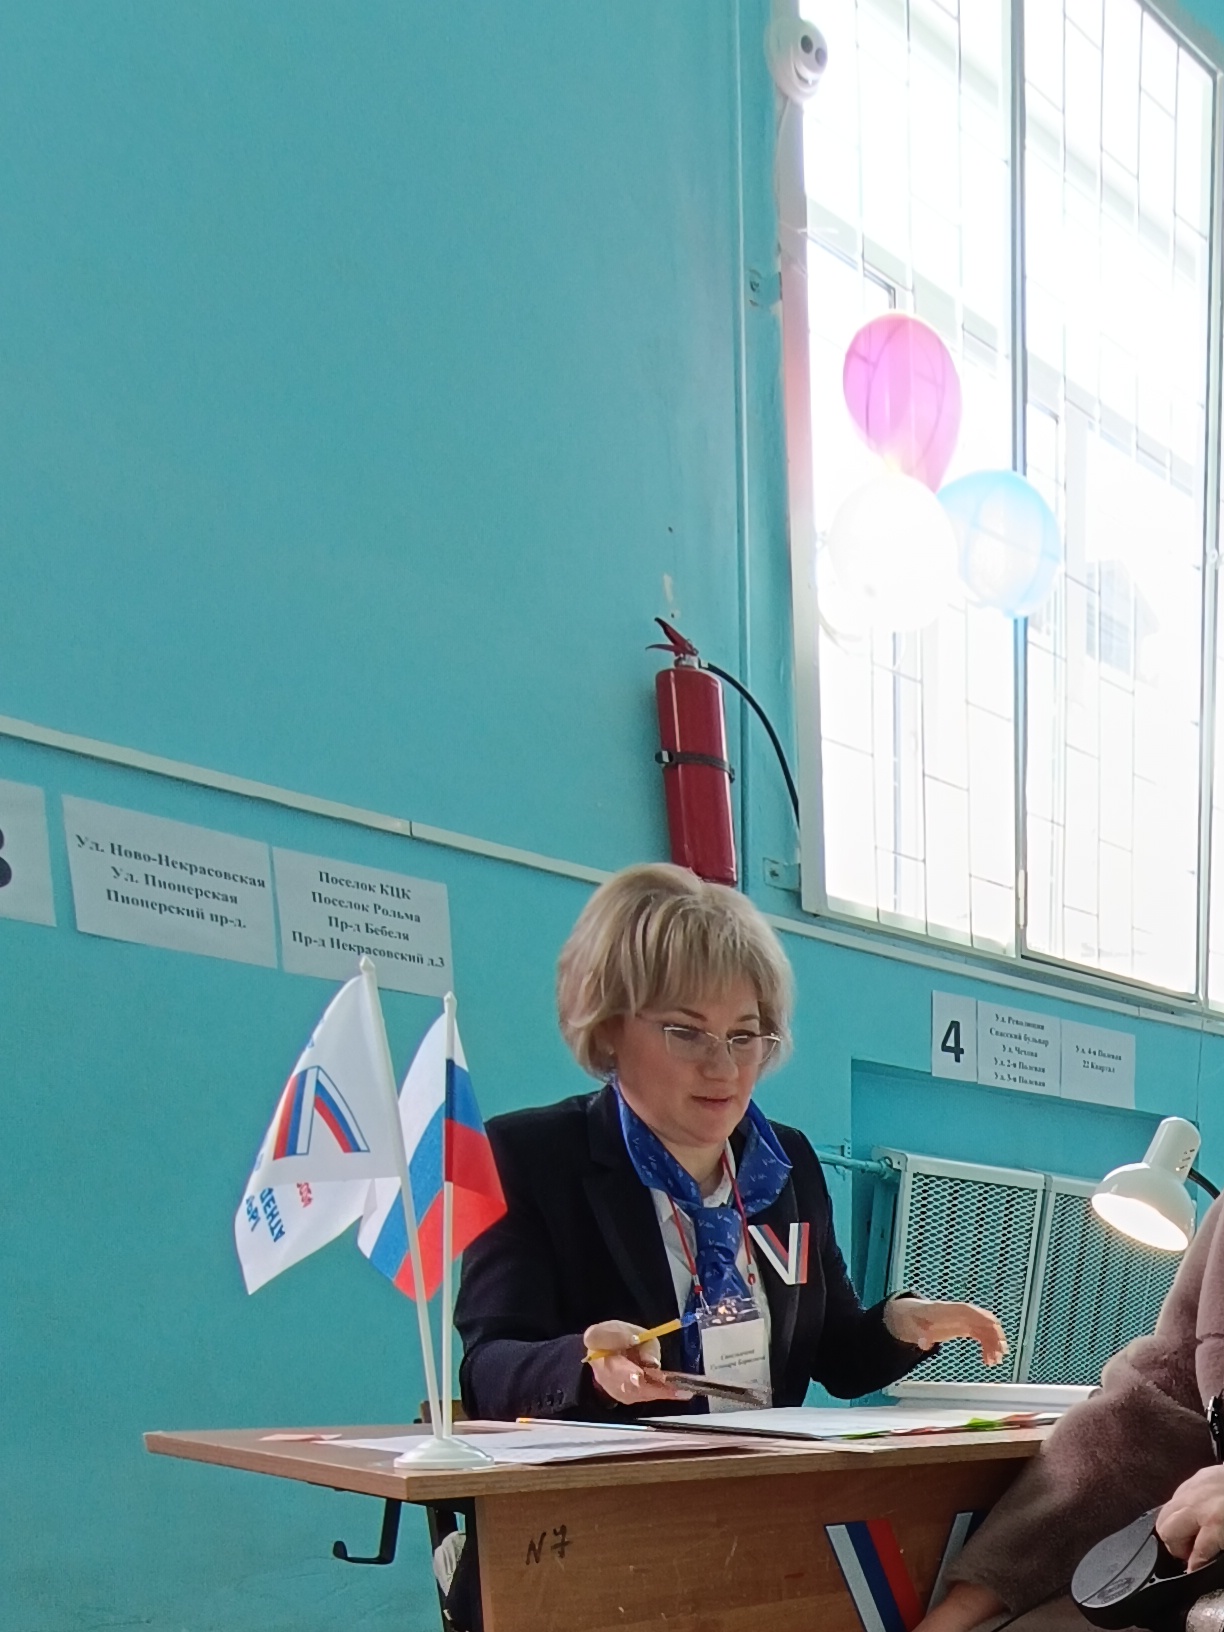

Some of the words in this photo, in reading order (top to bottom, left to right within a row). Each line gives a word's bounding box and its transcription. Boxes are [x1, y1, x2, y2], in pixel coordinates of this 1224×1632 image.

[75, 834, 105, 853] Ул.
[110, 842, 266, 888] Ново-Некрасовская
[111, 865, 139, 884] Ул.
[144, 873, 238, 904] Пионерская
[318, 871, 377, 893] Поселок
[379, 883, 412, 900] КЦК
[106, 888, 205, 920] Пионерский
[209, 914, 247, 929] пр-д.
[311, 891, 370, 913] Поселок
[373, 903, 421, 923] Рольма
[328, 915, 361, 933] Пр-д
[364, 922, 410, 941] Бебеля
[292, 930, 326, 947] Пр-д
[330, 937, 424, 965] Некрасовский
[941, 1020, 965, 1063] 4
